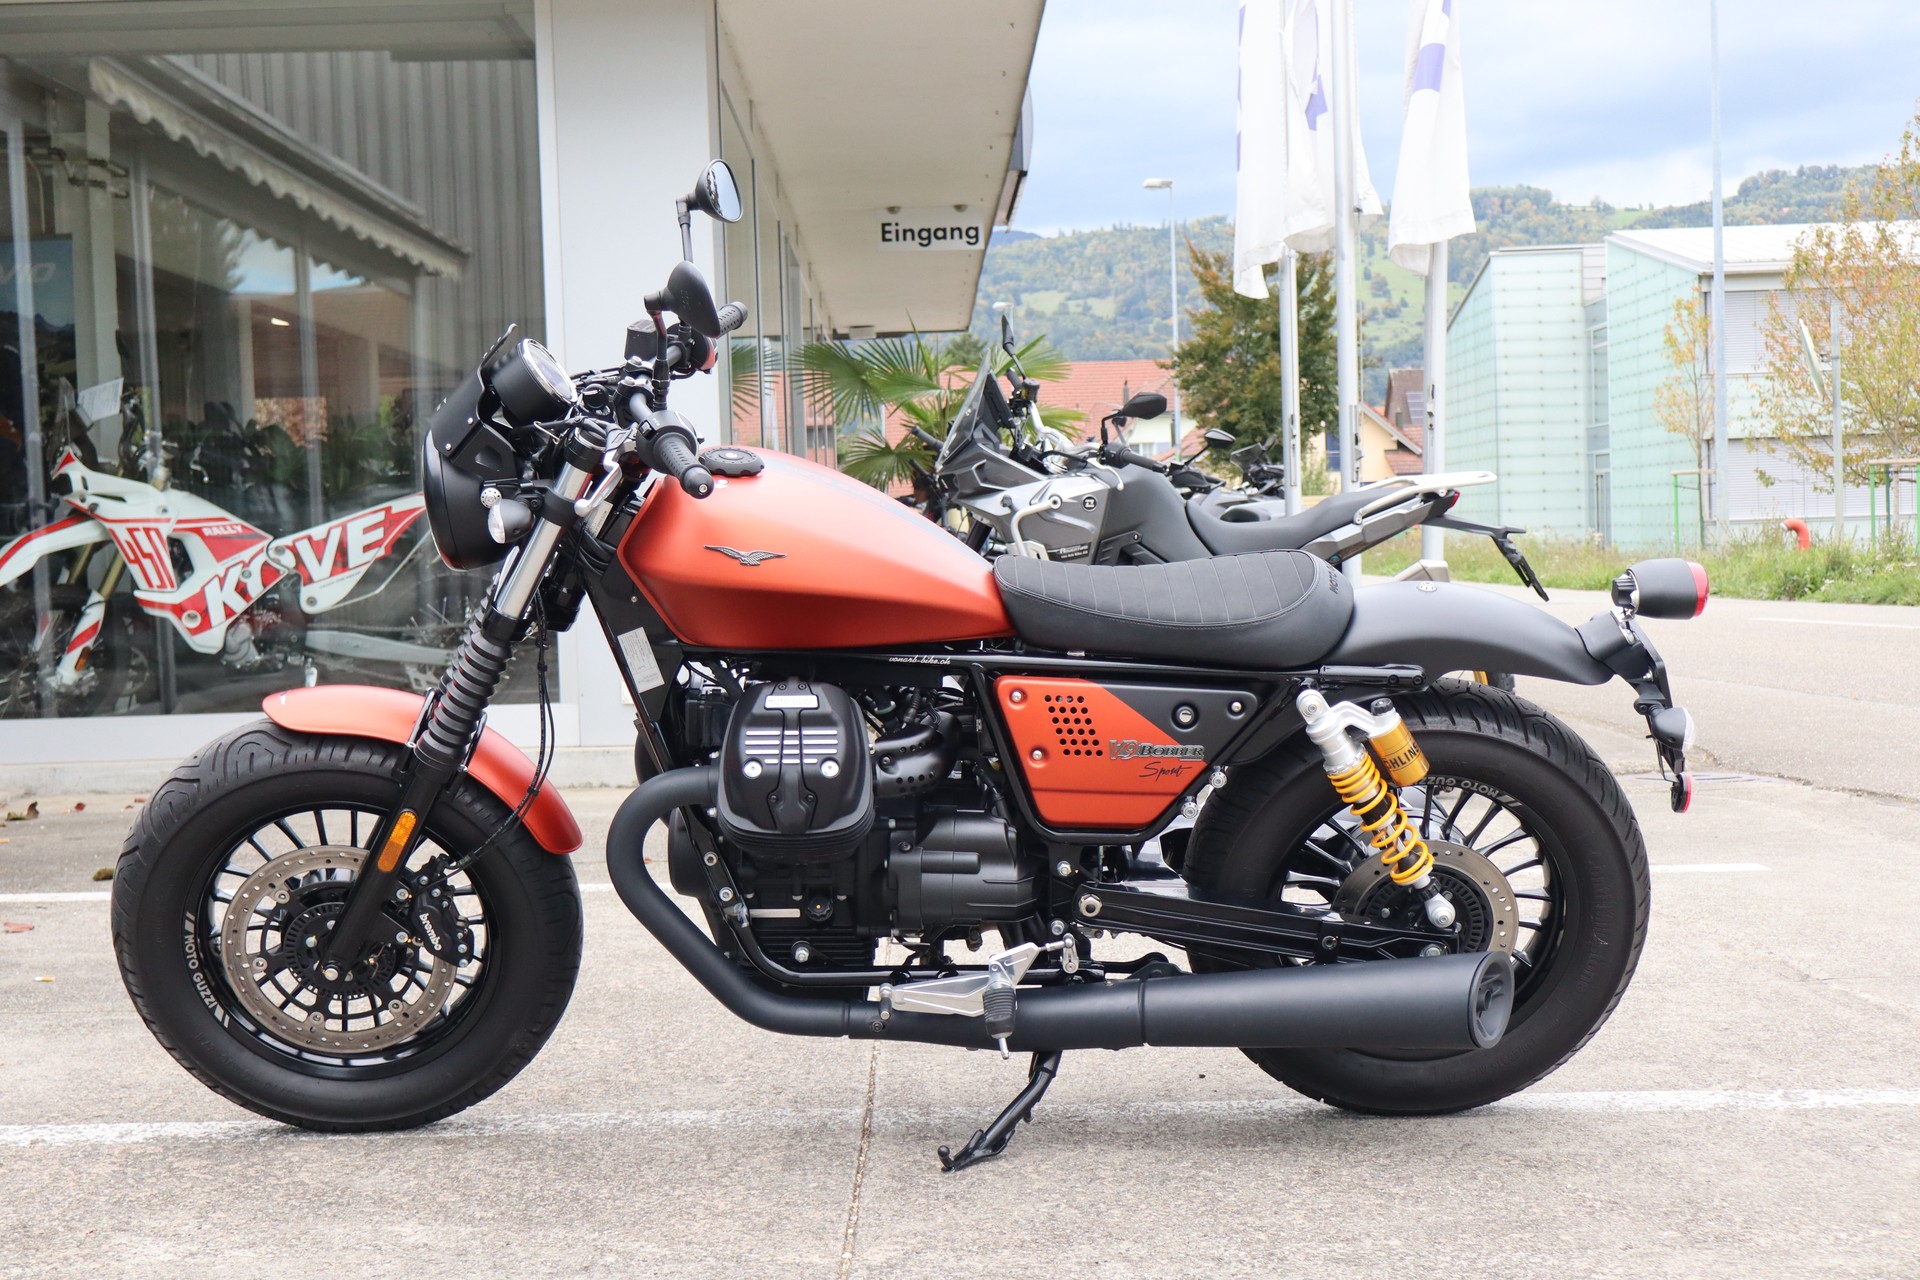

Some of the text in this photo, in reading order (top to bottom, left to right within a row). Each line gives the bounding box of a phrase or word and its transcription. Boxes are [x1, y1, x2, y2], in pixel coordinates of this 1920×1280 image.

[881, 222, 980, 247] Eingang
[202, 524, 243, 537] RALLY
[204, 508, 388, 628] KOVE
[1109, 739, 1139, 760] V9
[1139, 761, 1193, 782] Sport
[1417, 776, 1500, 798] MOTO GUZZ
[419, 912, 442, 951] brembo
[184, 934, 218, 1009] MOTO GUZZI
